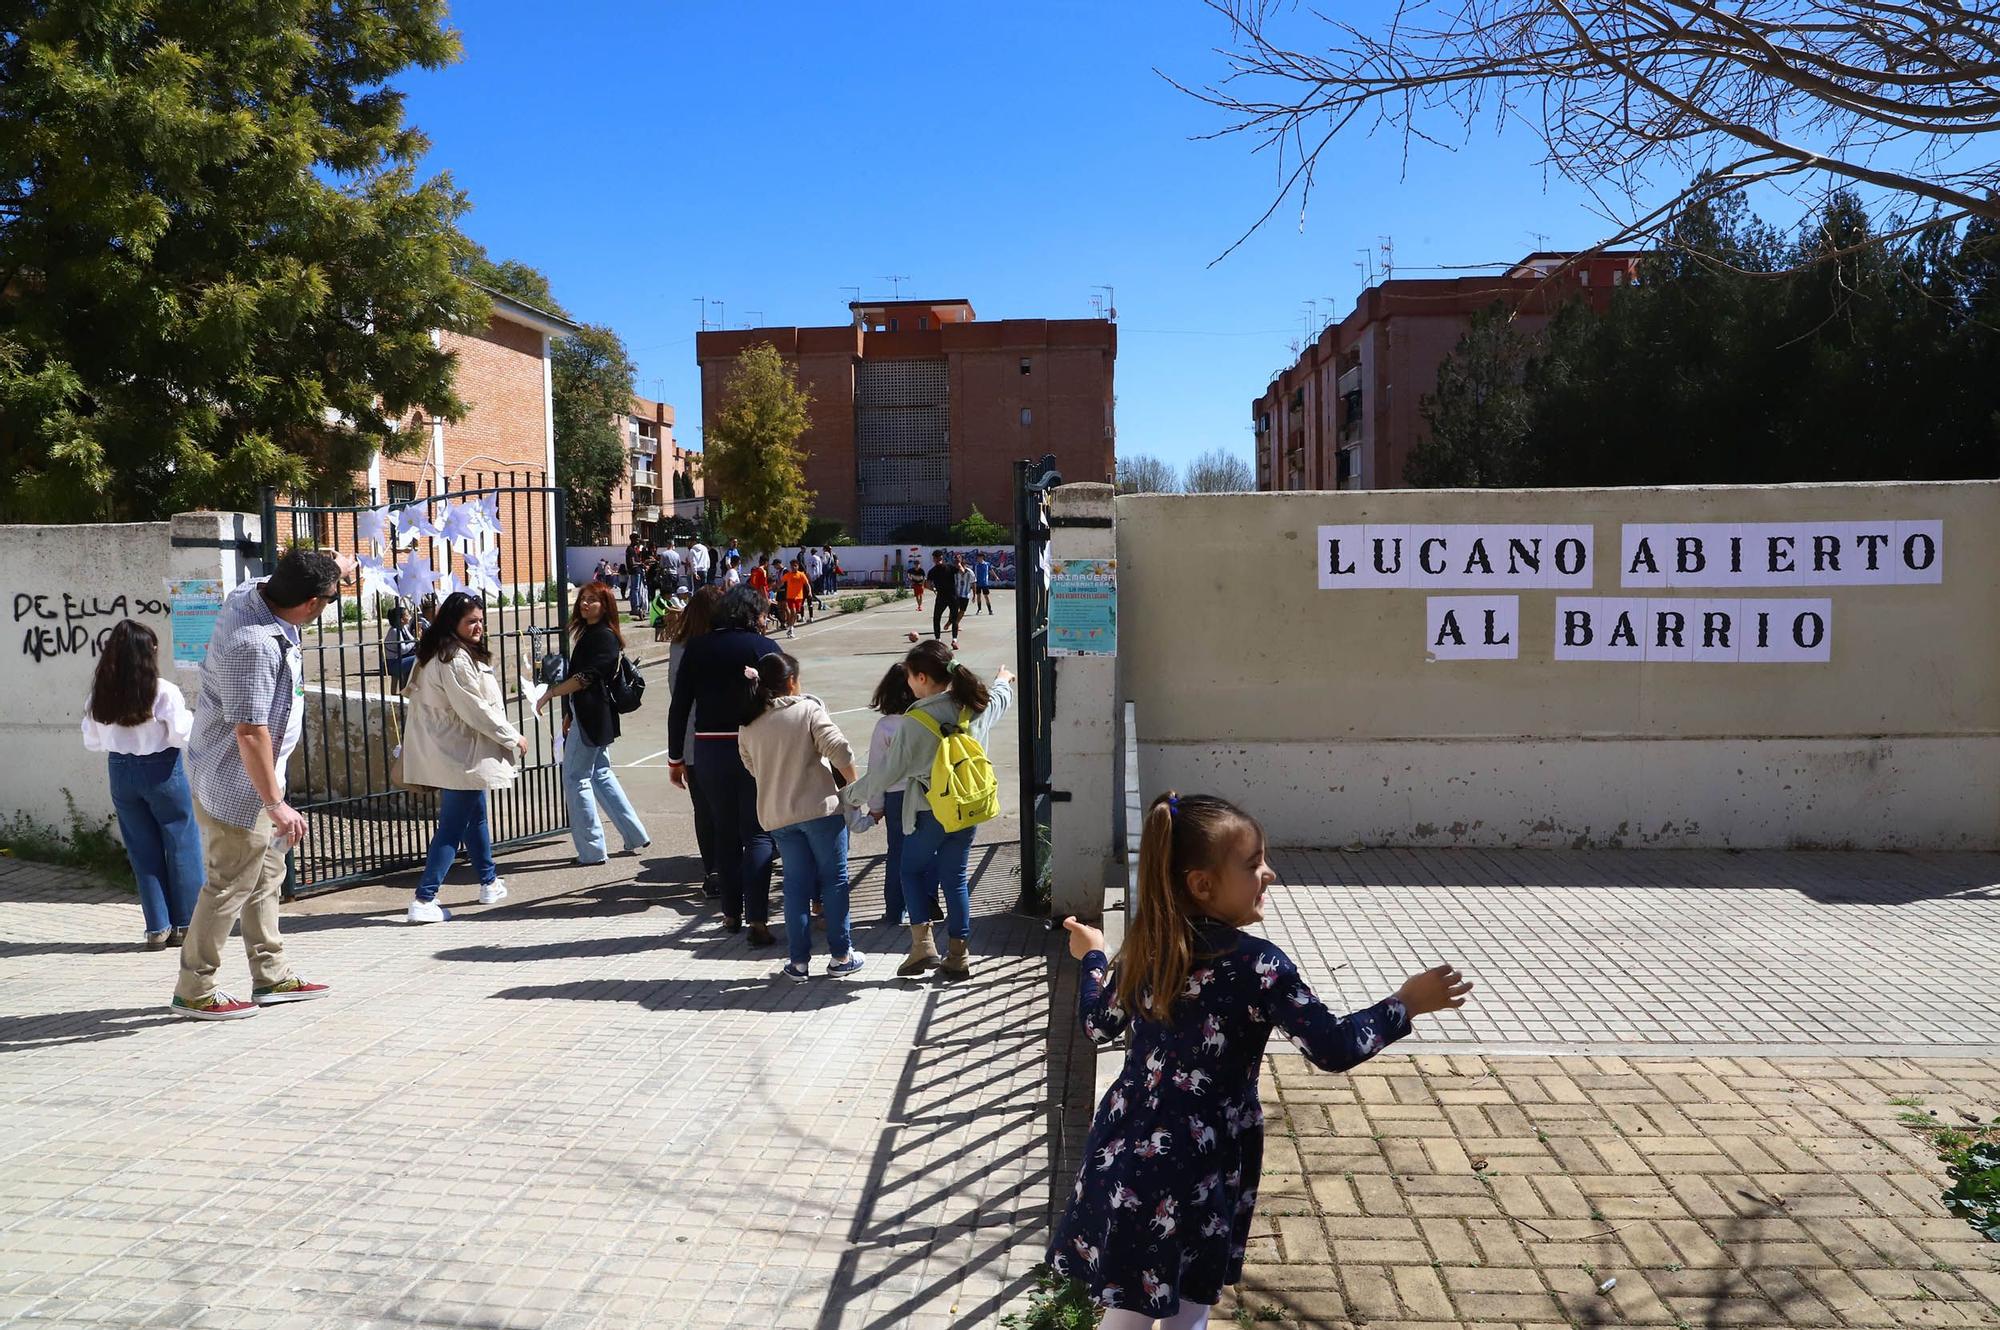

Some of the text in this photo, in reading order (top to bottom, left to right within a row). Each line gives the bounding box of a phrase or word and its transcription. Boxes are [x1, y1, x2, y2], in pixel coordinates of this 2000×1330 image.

[1329, 534, 1935, 574] LUCANO ABIERTO
[1050, 574, 1115, 582] PRIMAVERA
[14, 593, 58, 622] DE
[62, 593, 129, 619] ELLA
[1435, 610, 1824, 648] AL BARRIO
